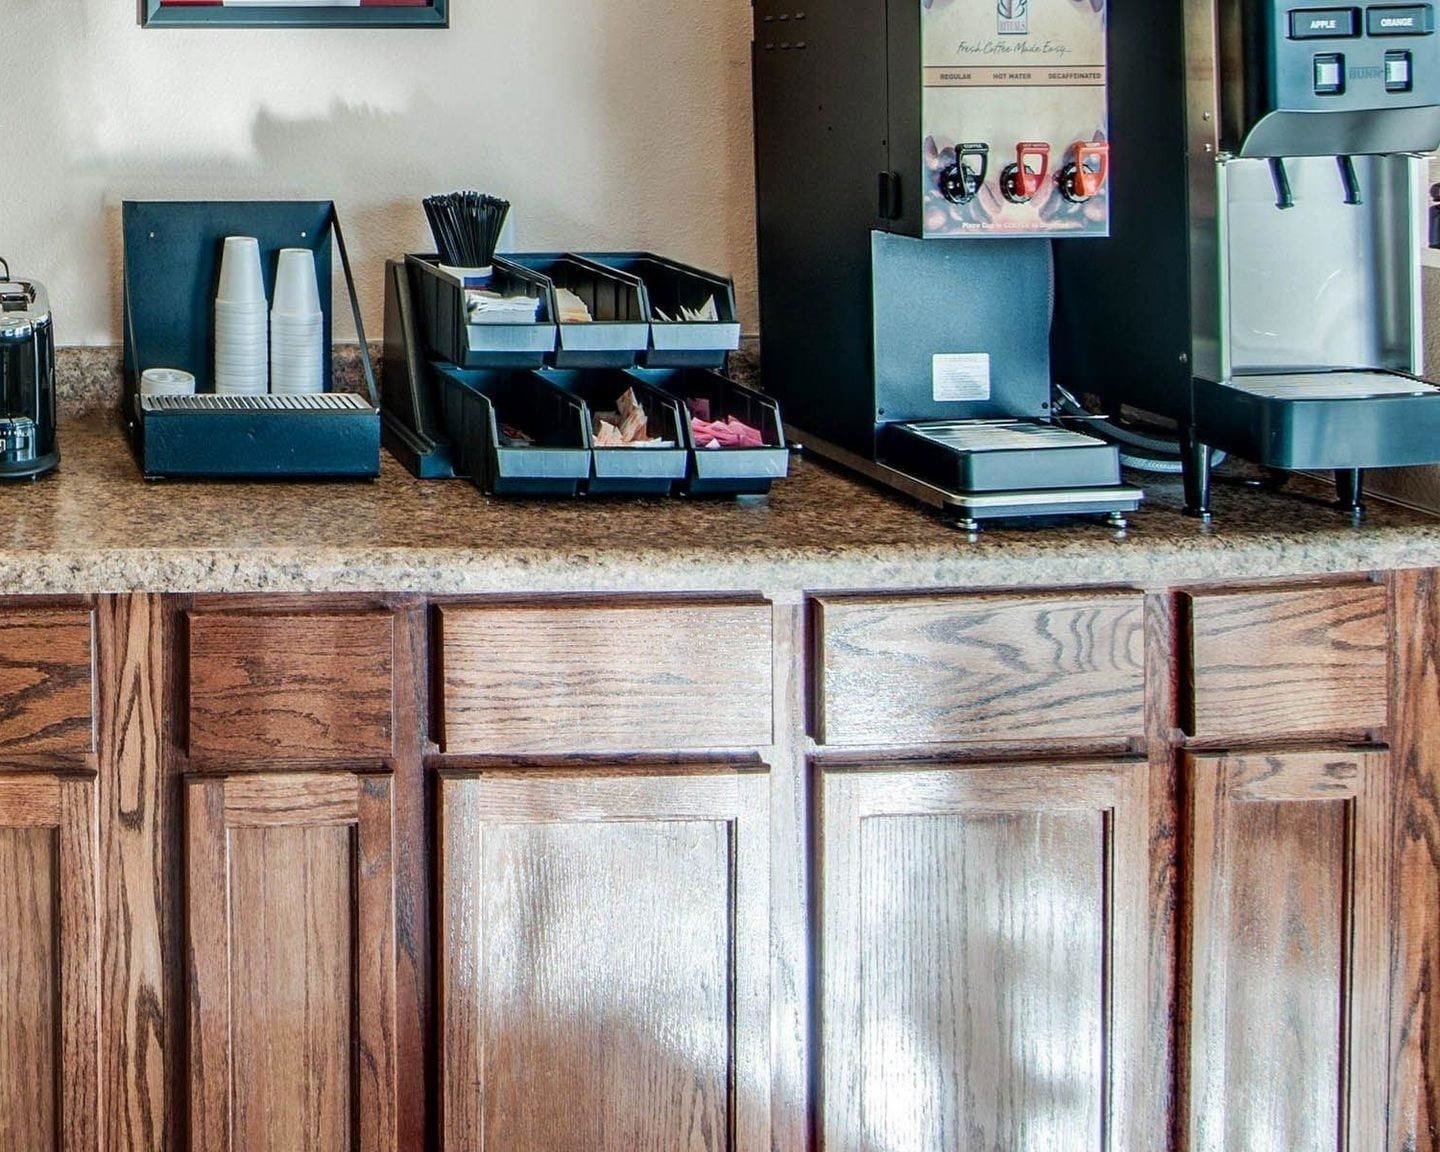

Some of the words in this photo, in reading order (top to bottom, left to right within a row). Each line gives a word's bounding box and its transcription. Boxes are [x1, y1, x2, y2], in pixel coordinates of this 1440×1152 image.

[1310, 19, 1337, 30] APPLE
[1380, 17, 1414, 27] ORANGE
[957, 41, 981, 56] Fresh
[983, 40, 1011, 54] Coffee
[1047, 72, 1102, 80] DECAFFEINATED
